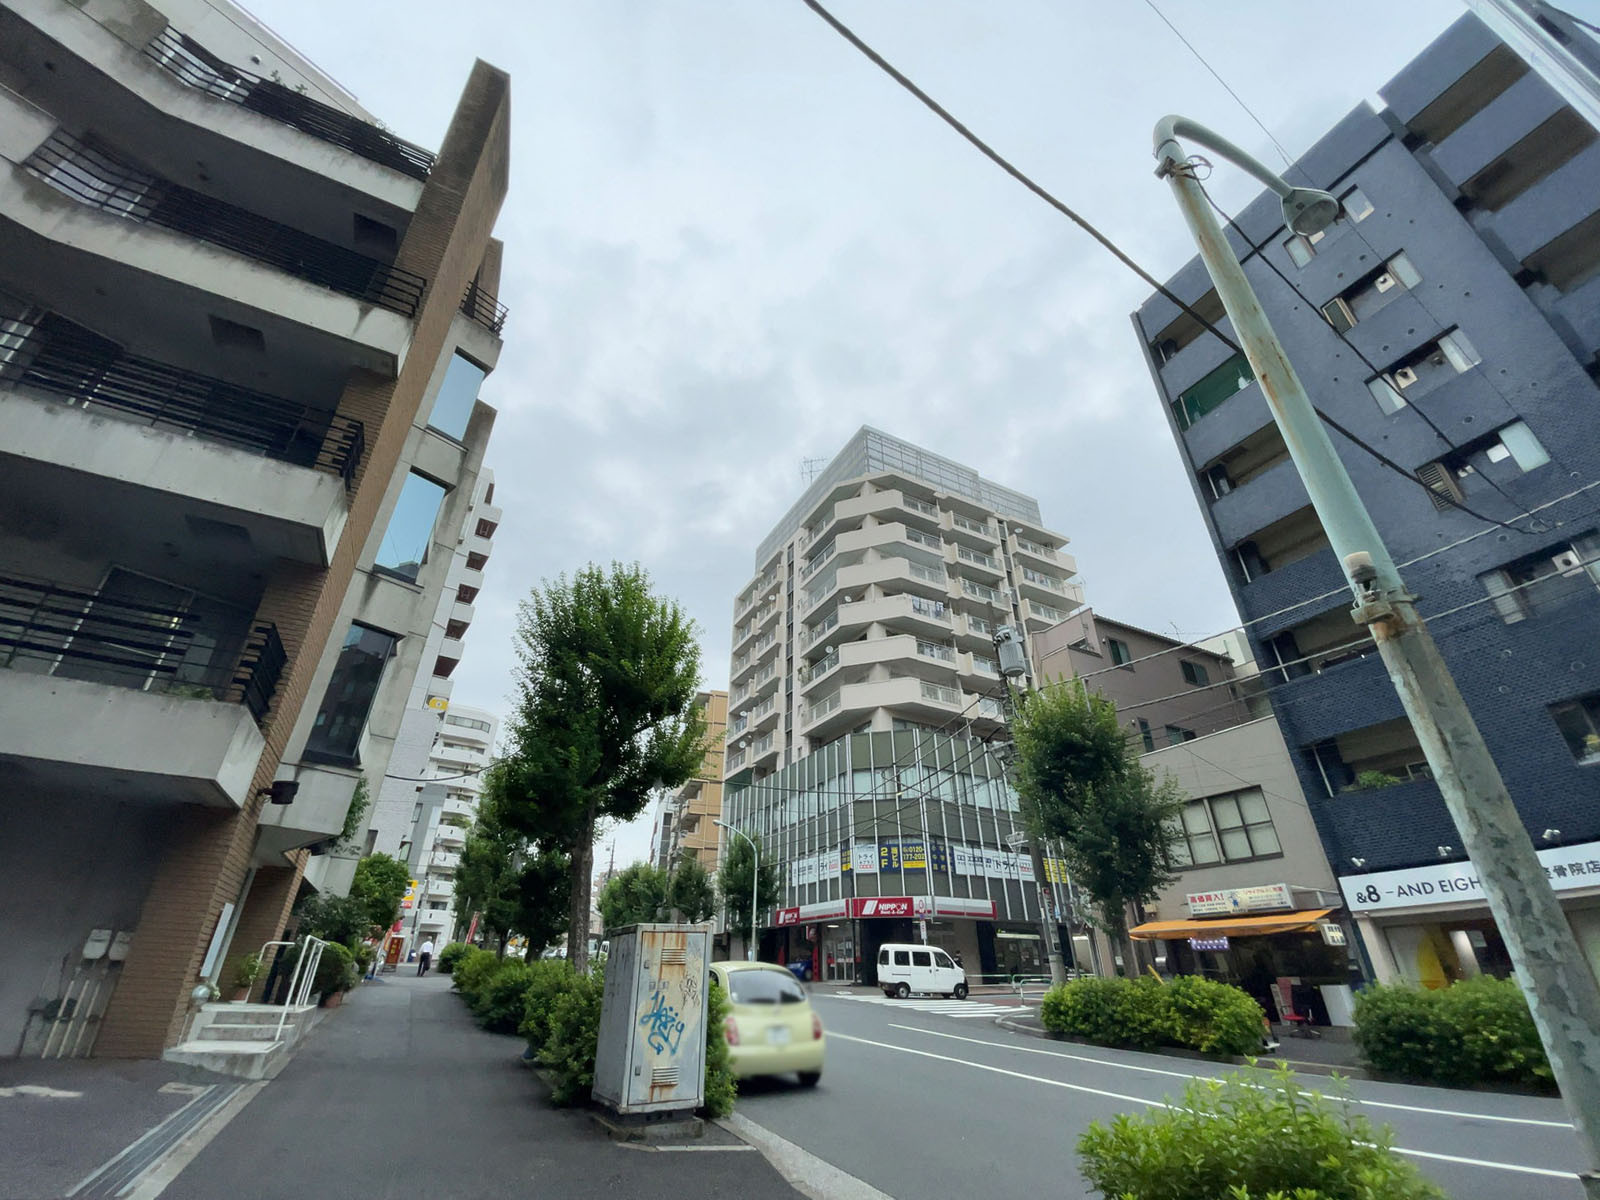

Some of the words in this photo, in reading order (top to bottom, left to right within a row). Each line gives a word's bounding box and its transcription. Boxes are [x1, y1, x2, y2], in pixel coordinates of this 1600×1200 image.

[1356, 884, 1381, 904] &8
[1438, 876, 1484, 893] EIGH
[879, 903, 908, 911] NIPPON
